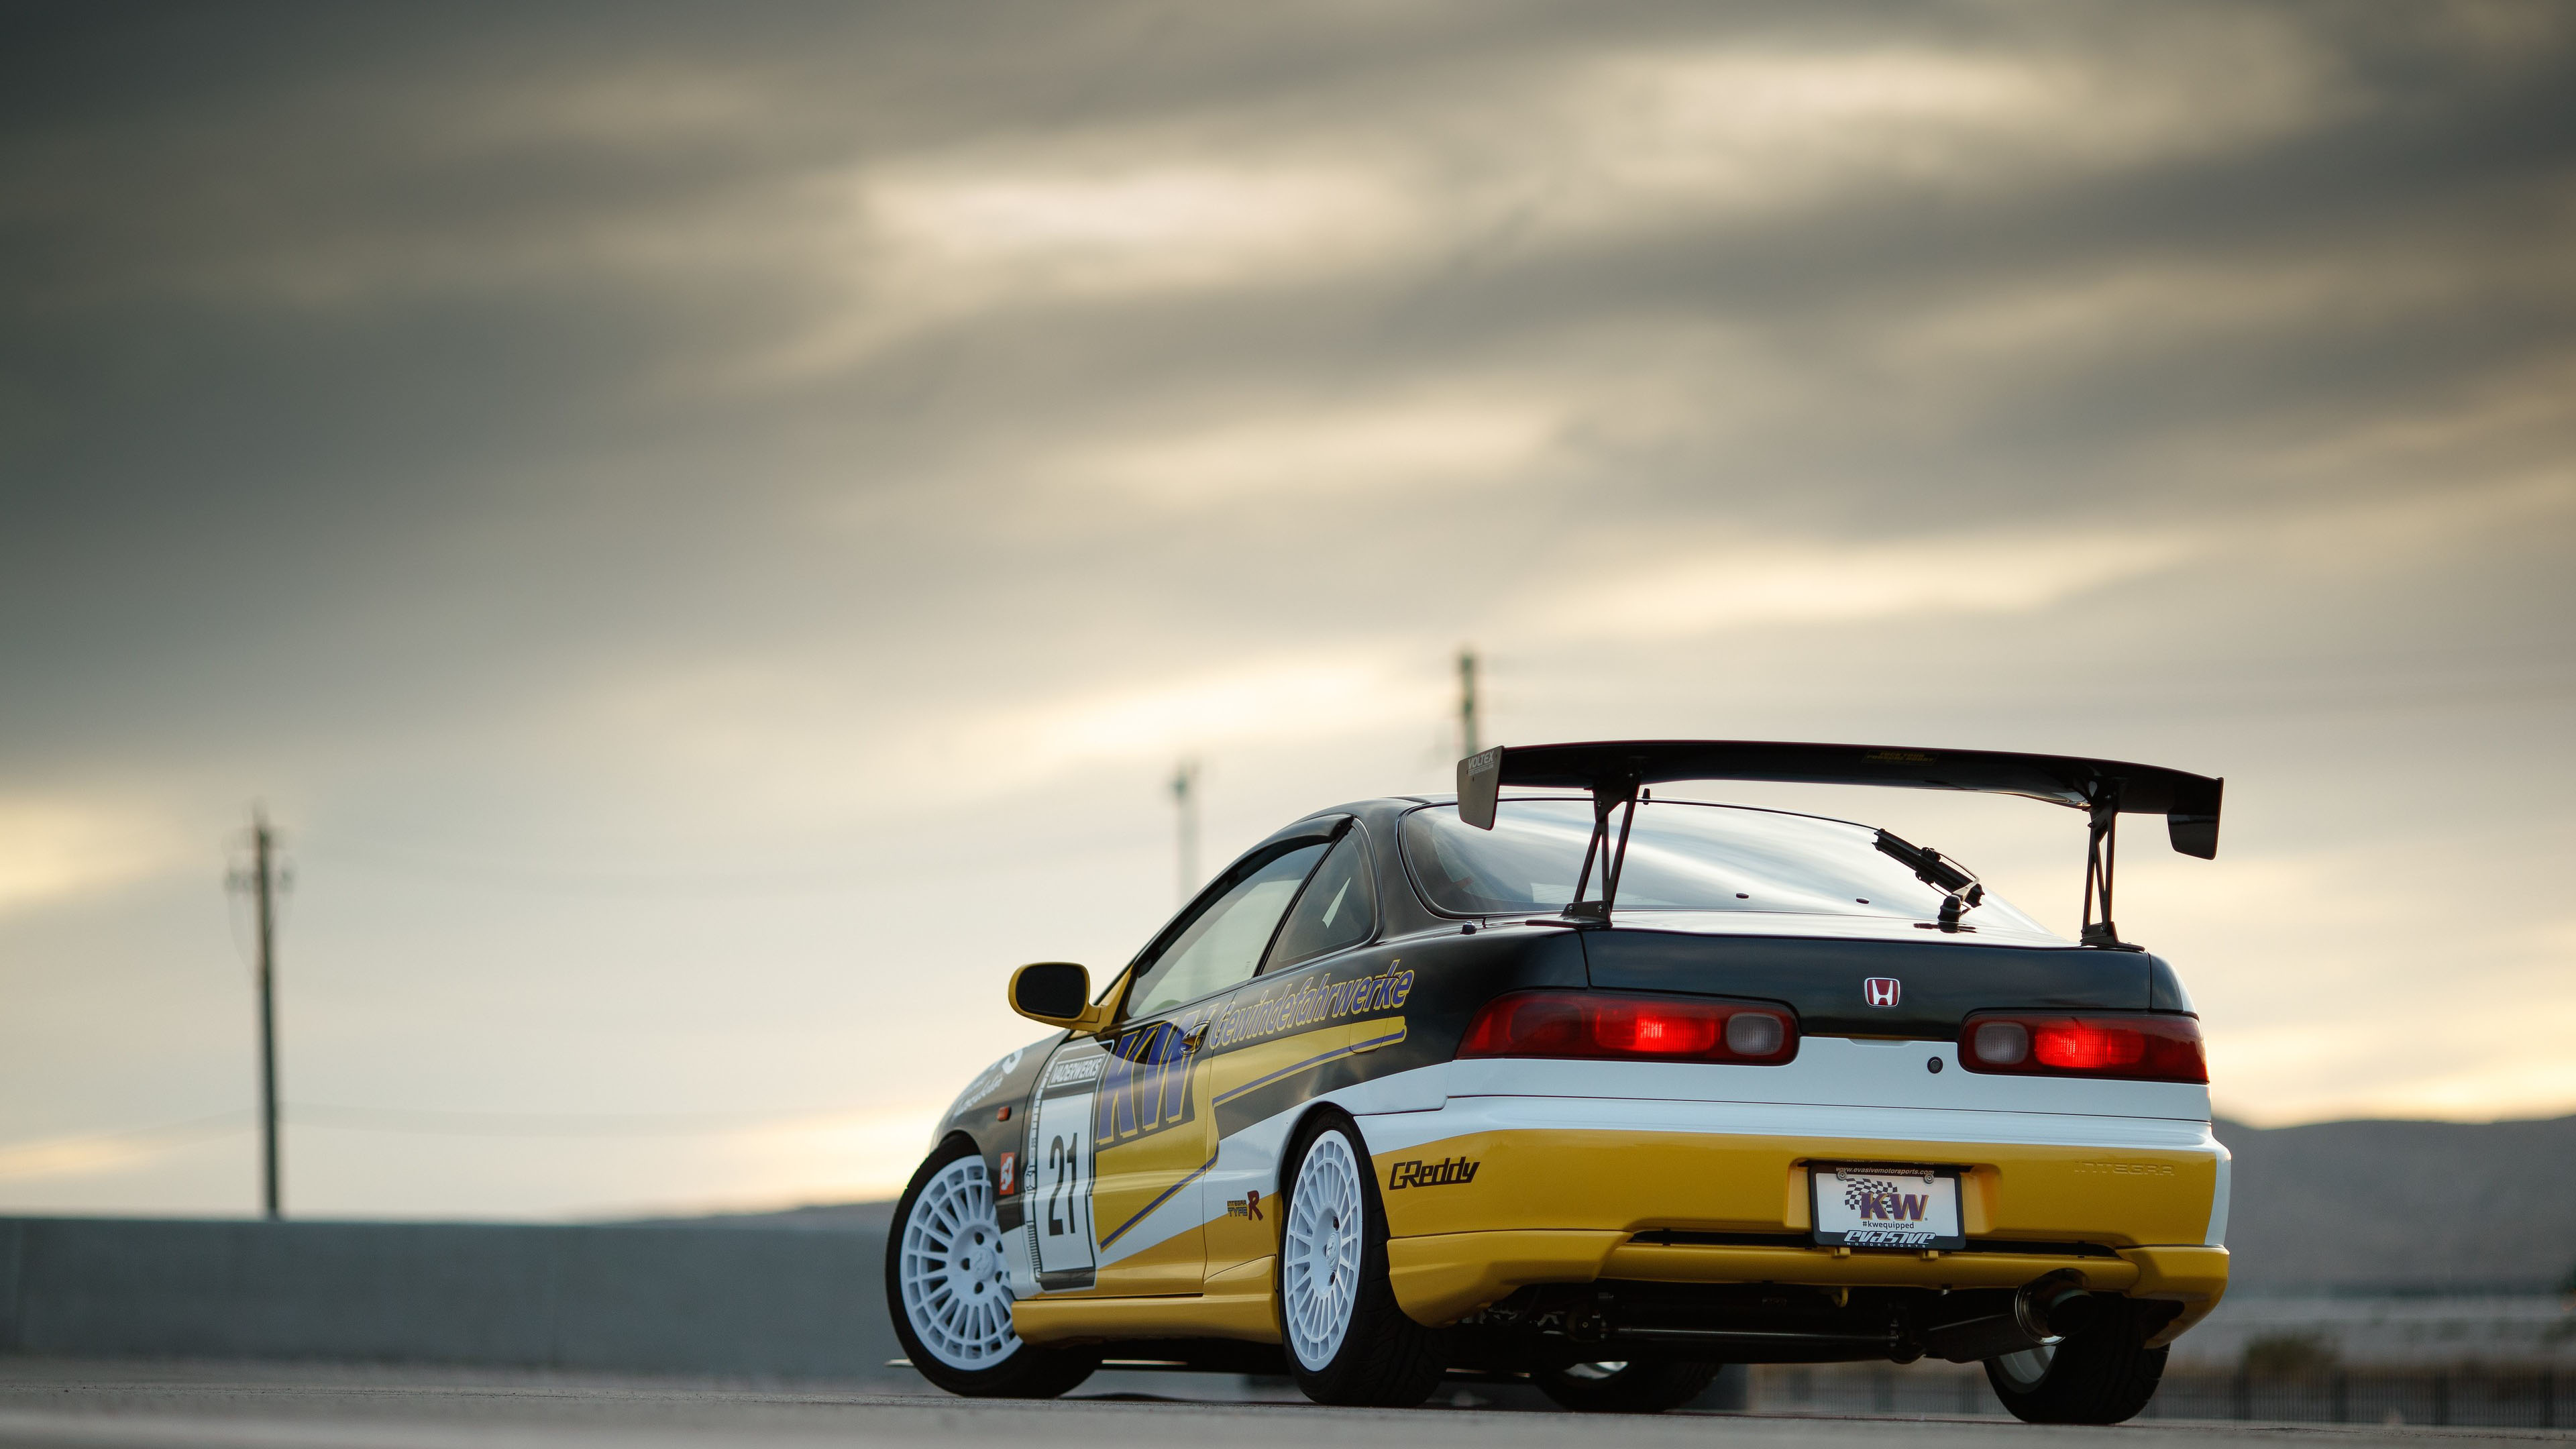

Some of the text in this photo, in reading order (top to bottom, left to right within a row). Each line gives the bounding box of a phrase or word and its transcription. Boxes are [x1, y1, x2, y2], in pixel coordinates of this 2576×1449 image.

[1468, 751, 1494, 769] VOLTEX
[1210, 959, 1415, 1050] Gewindefahrwerke
[1389, 1157, 1481, 1190] GReddy
[1835, 1167, 1935, 1175] www.evasivemotorsports.com
[2074, 1161, 2175, 1175] INTEGRA
[1049, 1132, 1077, 1236] 21
[1247, 1190, 1263, 1221] R
[1860, 1192, 1929, 1221] KW
[1862, 1220, 1915, 1230] #kwequipped
